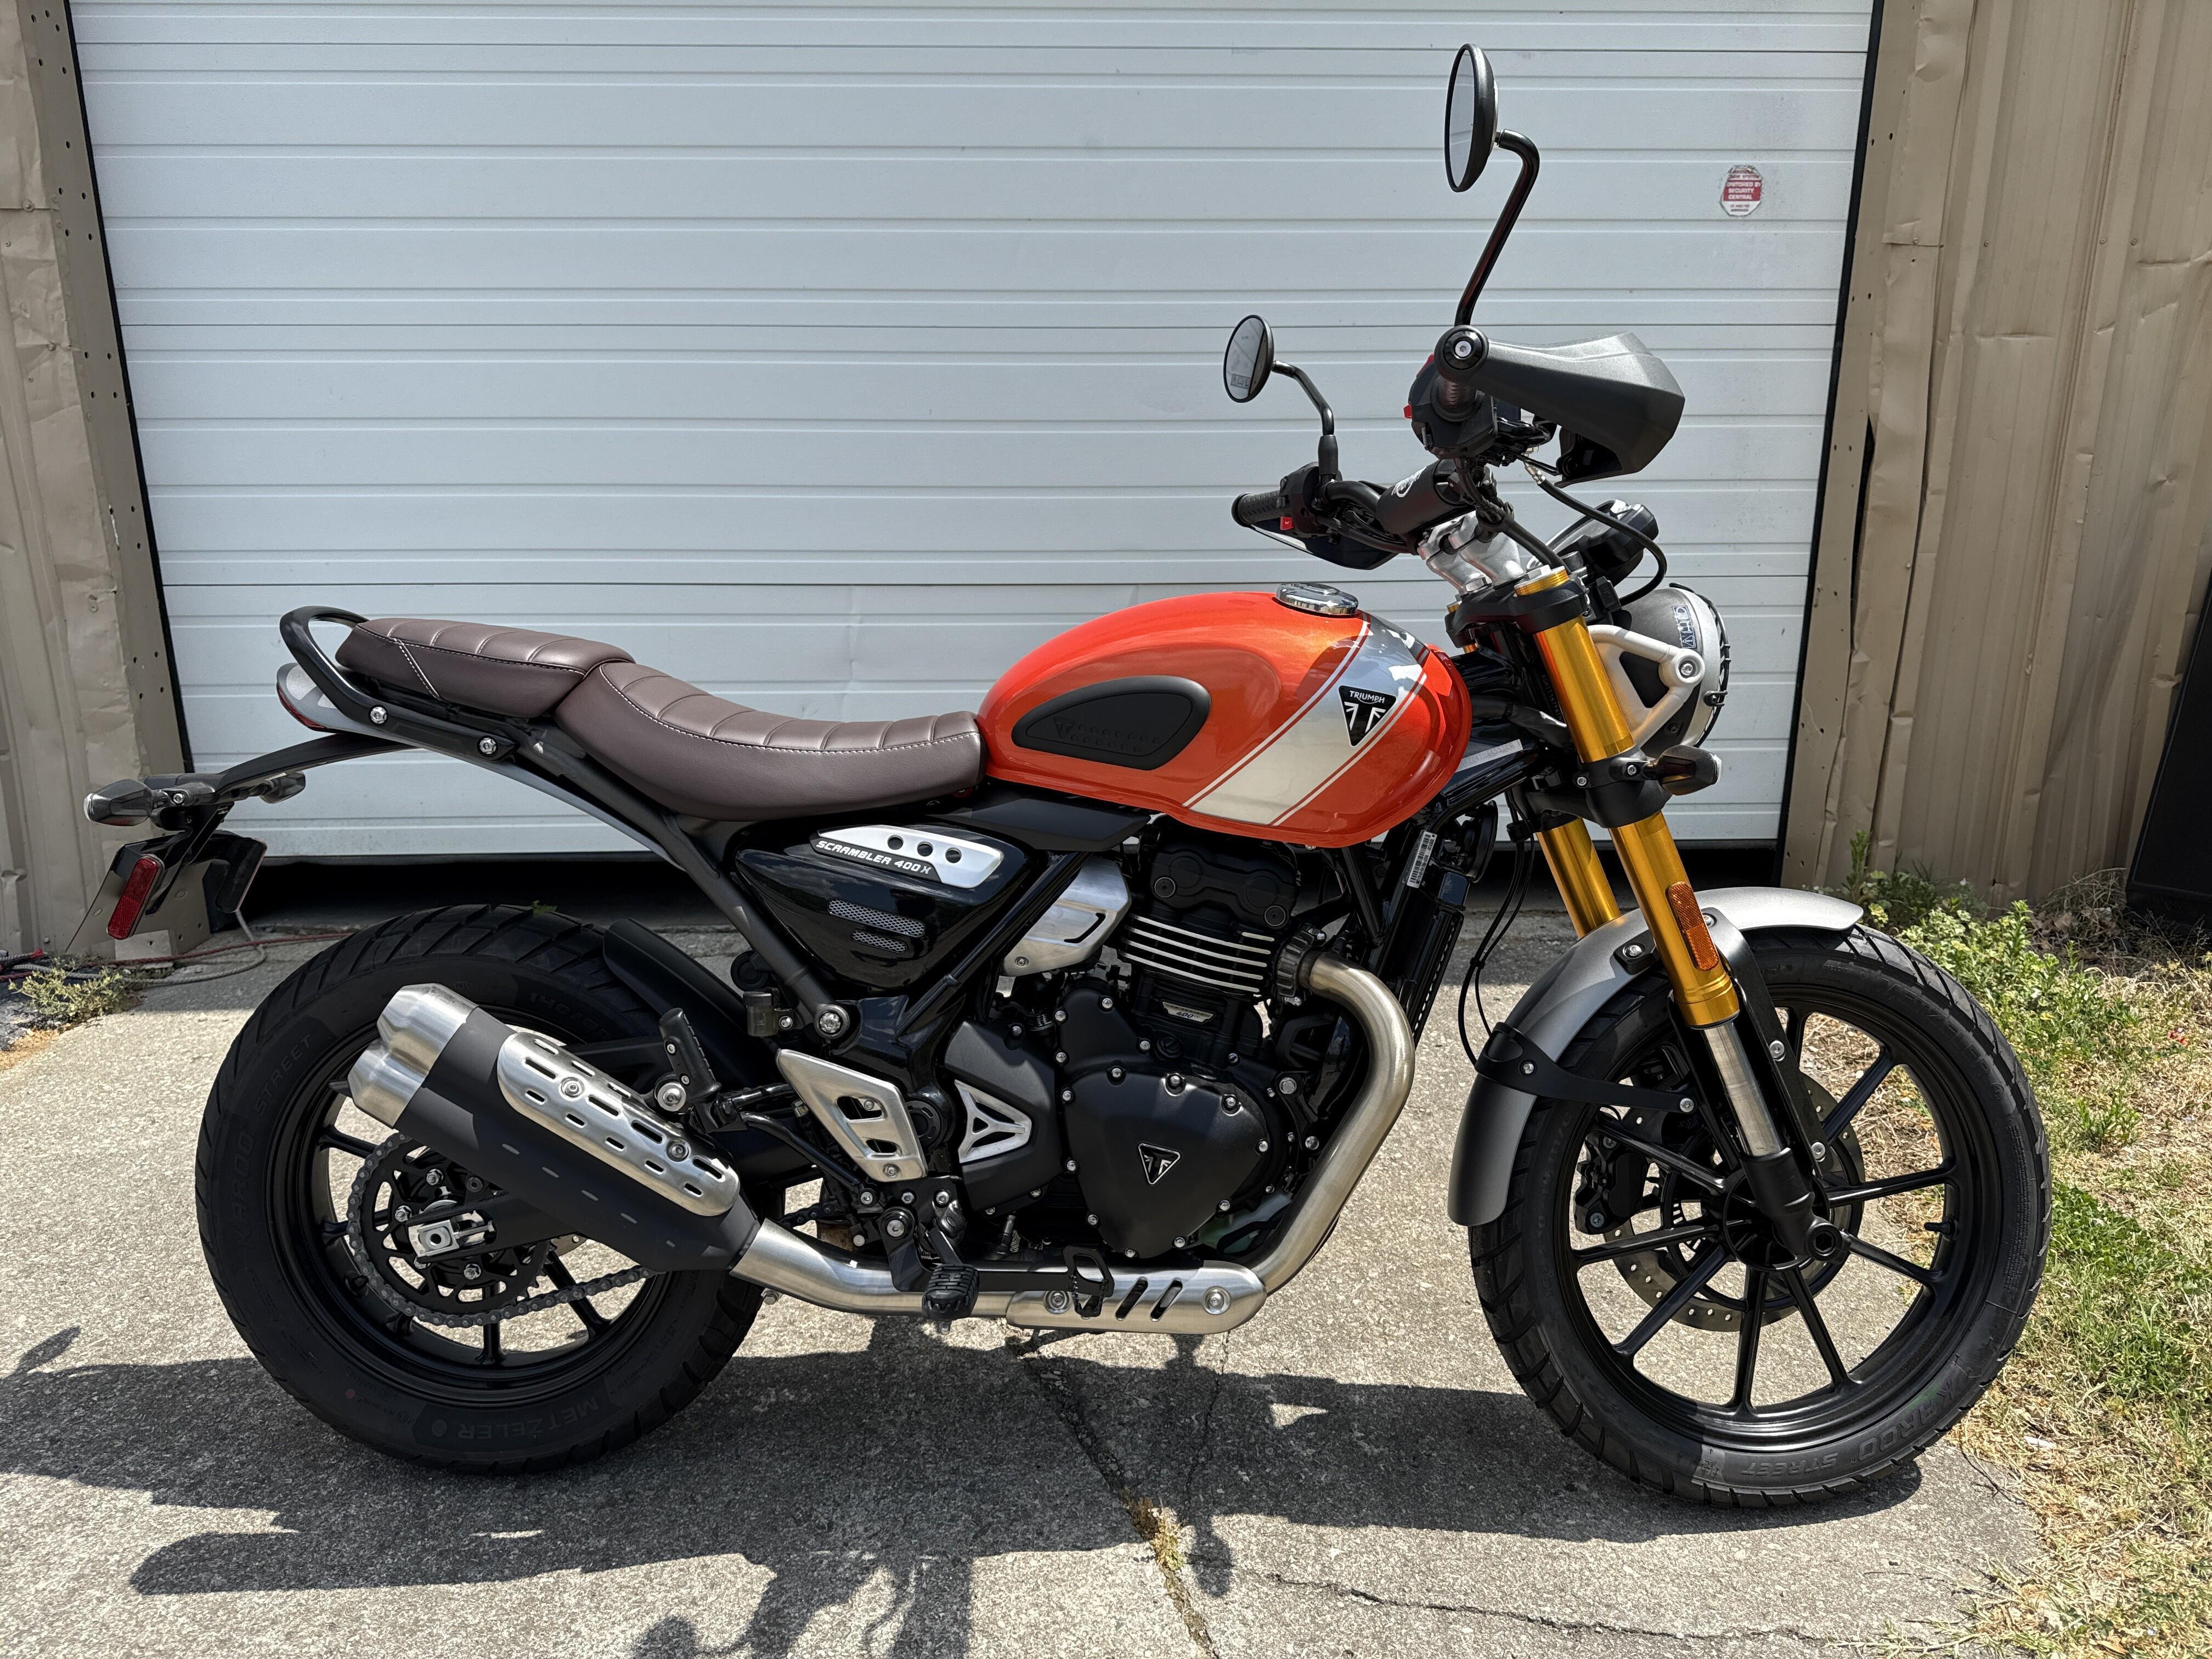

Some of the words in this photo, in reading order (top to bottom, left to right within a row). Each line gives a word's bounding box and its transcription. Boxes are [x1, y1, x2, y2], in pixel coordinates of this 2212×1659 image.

[1350, 691, 1385, 704] TRIUMPH
[816, 840, 891, 865] SCRAMBLER
[232, 1131, 256, 1250] KAROO
[255, 1034, 311, 1117] STREET
[458, 1395, 600, 1439] METZELER
[1859, 1379, 1954, 1462] KAROO
[1741, 1452, 1838, 1476] STREET
